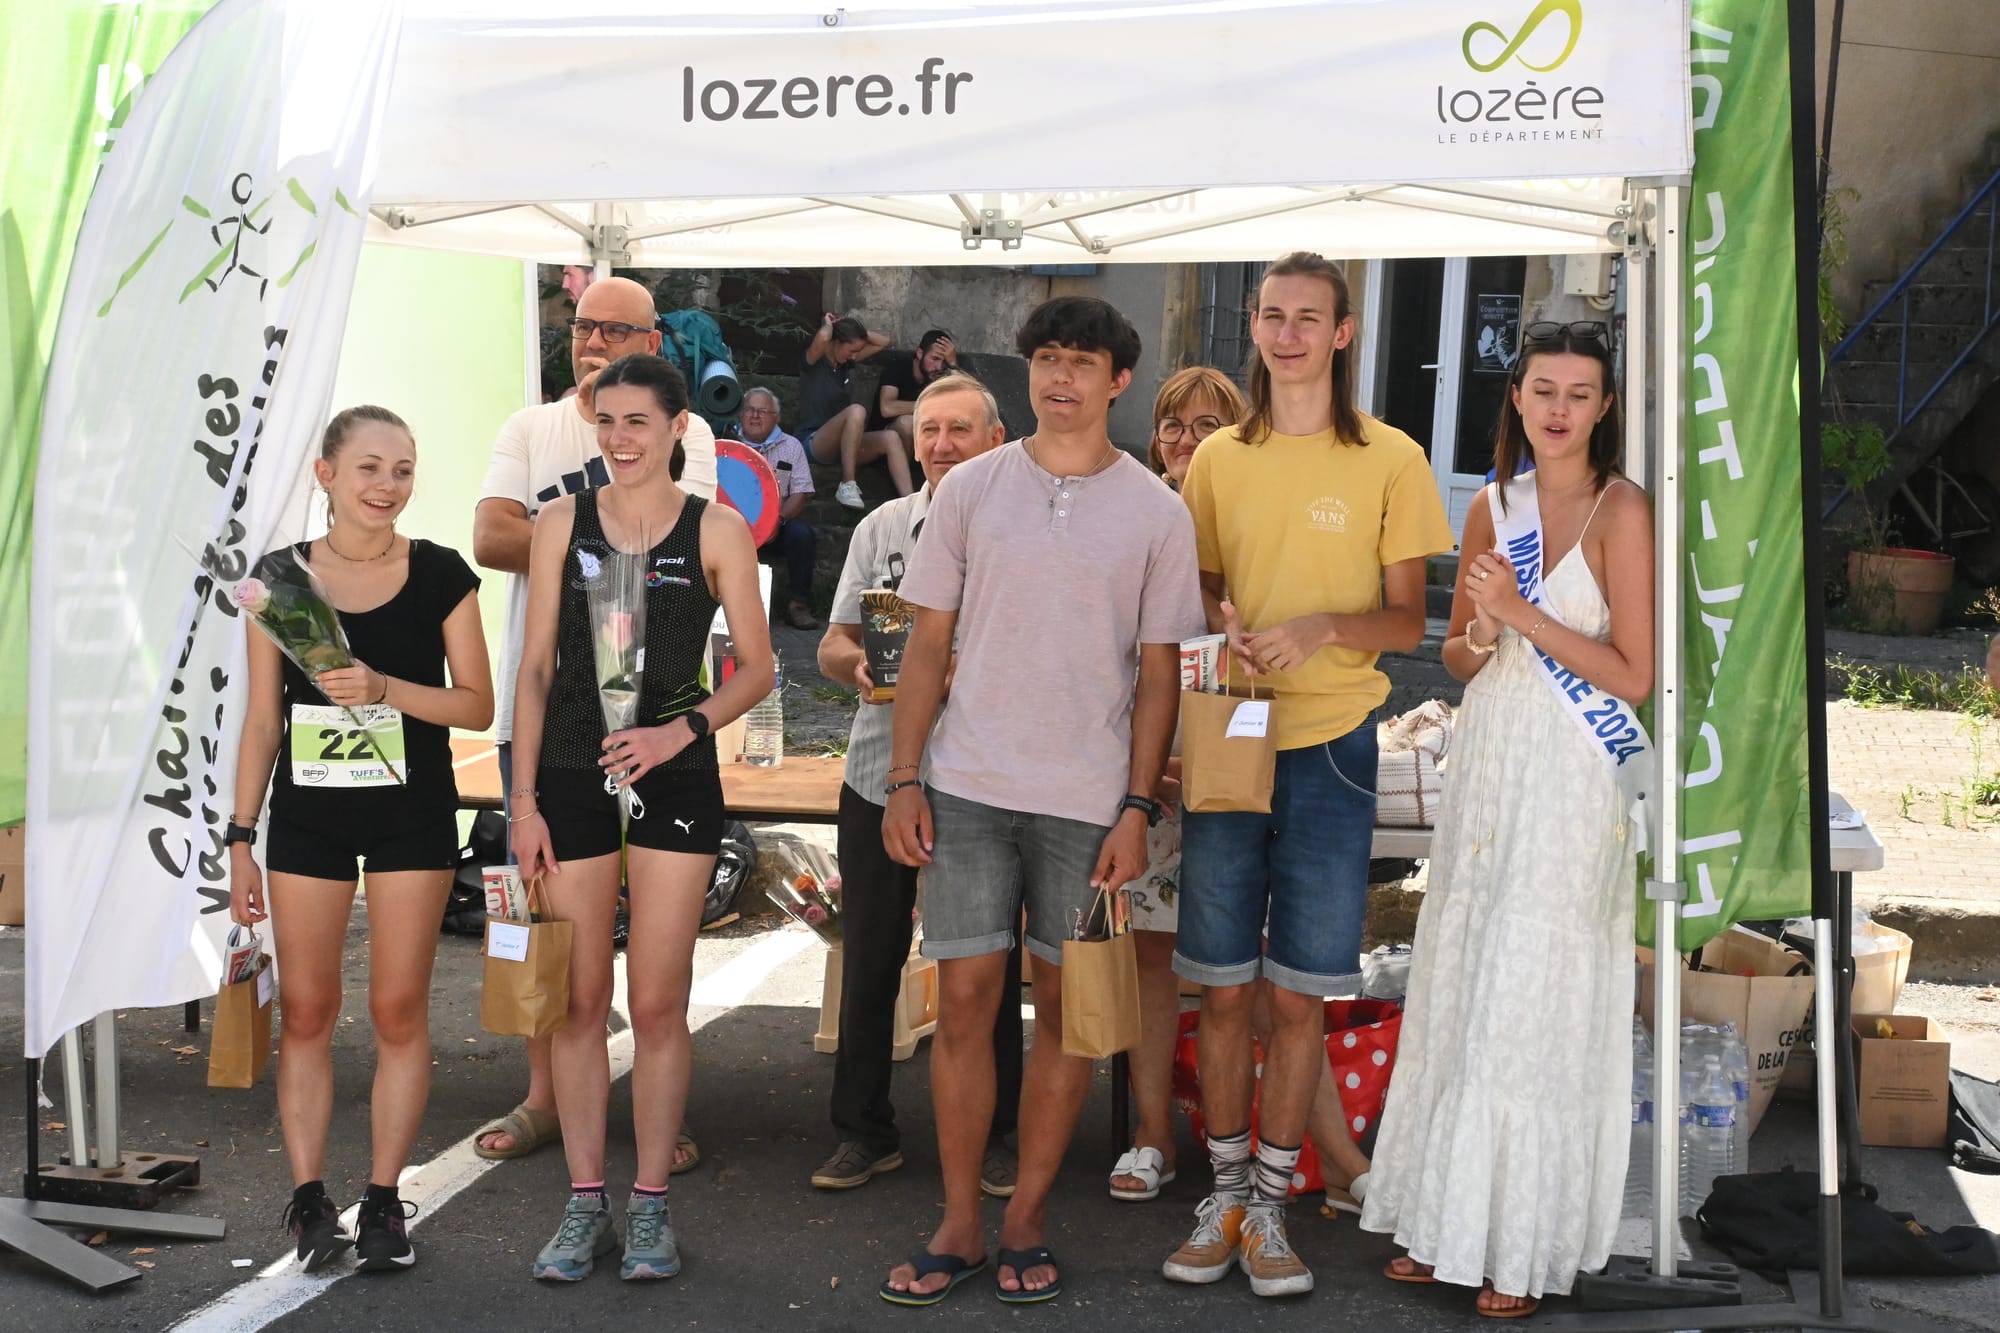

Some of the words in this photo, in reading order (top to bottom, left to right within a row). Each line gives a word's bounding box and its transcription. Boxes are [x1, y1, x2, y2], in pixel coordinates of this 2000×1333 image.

[683, 57, 974, 122] lozere.fr
[1438, 80, 1604, 124] lozère
[1438, 133, 1457, 144] LE
[1470, 129, 1604, 143] DÉPARTEMENT
[1312, 510, 1345, 526] VANS
[656, 557, 686, 567] poli
[319, 729, 374, 760] 22
[1583, 698, 1645, 767] 2024
[1758, 1052, 1772, 1071] DE
[1773, 1051, 1785, 1068] LA
